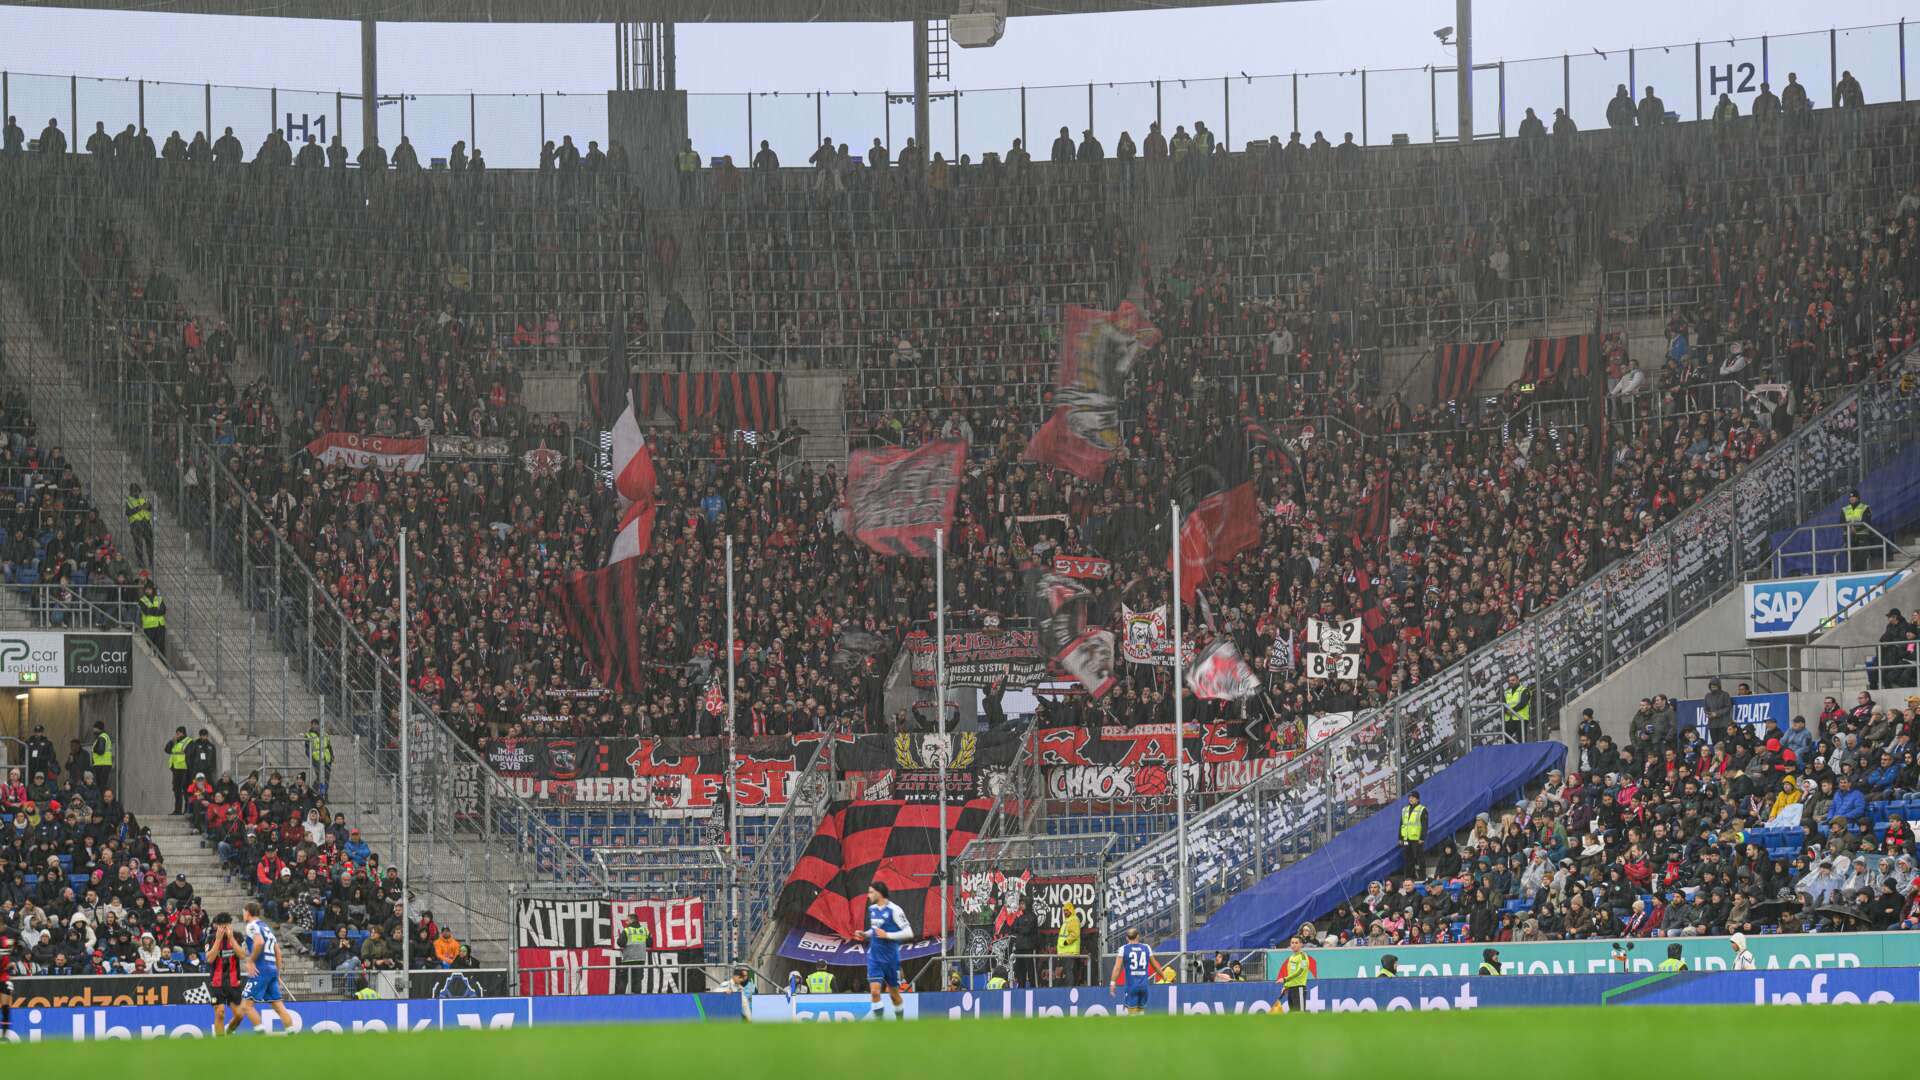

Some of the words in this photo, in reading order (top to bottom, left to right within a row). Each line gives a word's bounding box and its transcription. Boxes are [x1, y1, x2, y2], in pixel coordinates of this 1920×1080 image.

[1709, 62, 1756, 95] H2
[286, 112, 326, 143] H1
[1754, 591, 1803, 625] SAP
[32, 650, 59, 661] car
[100, 651, 127, 662] car
[7, 662, 59, 673] solutions
[76, 664, 128, 674] solutions
[499, 762, 521, 771] SVB
[1051, 764, 1135, 799] CHAOS
[1049, 883, 1096, 906] NORD
[519, 896, 702, 948] KÜPPERSTEG
[800, 940, 837, 951] SNP
[1129, 952, 1147, 970] 34
[550, 949, 589, 995] ON
[602, 949, 682, 995] TUR
